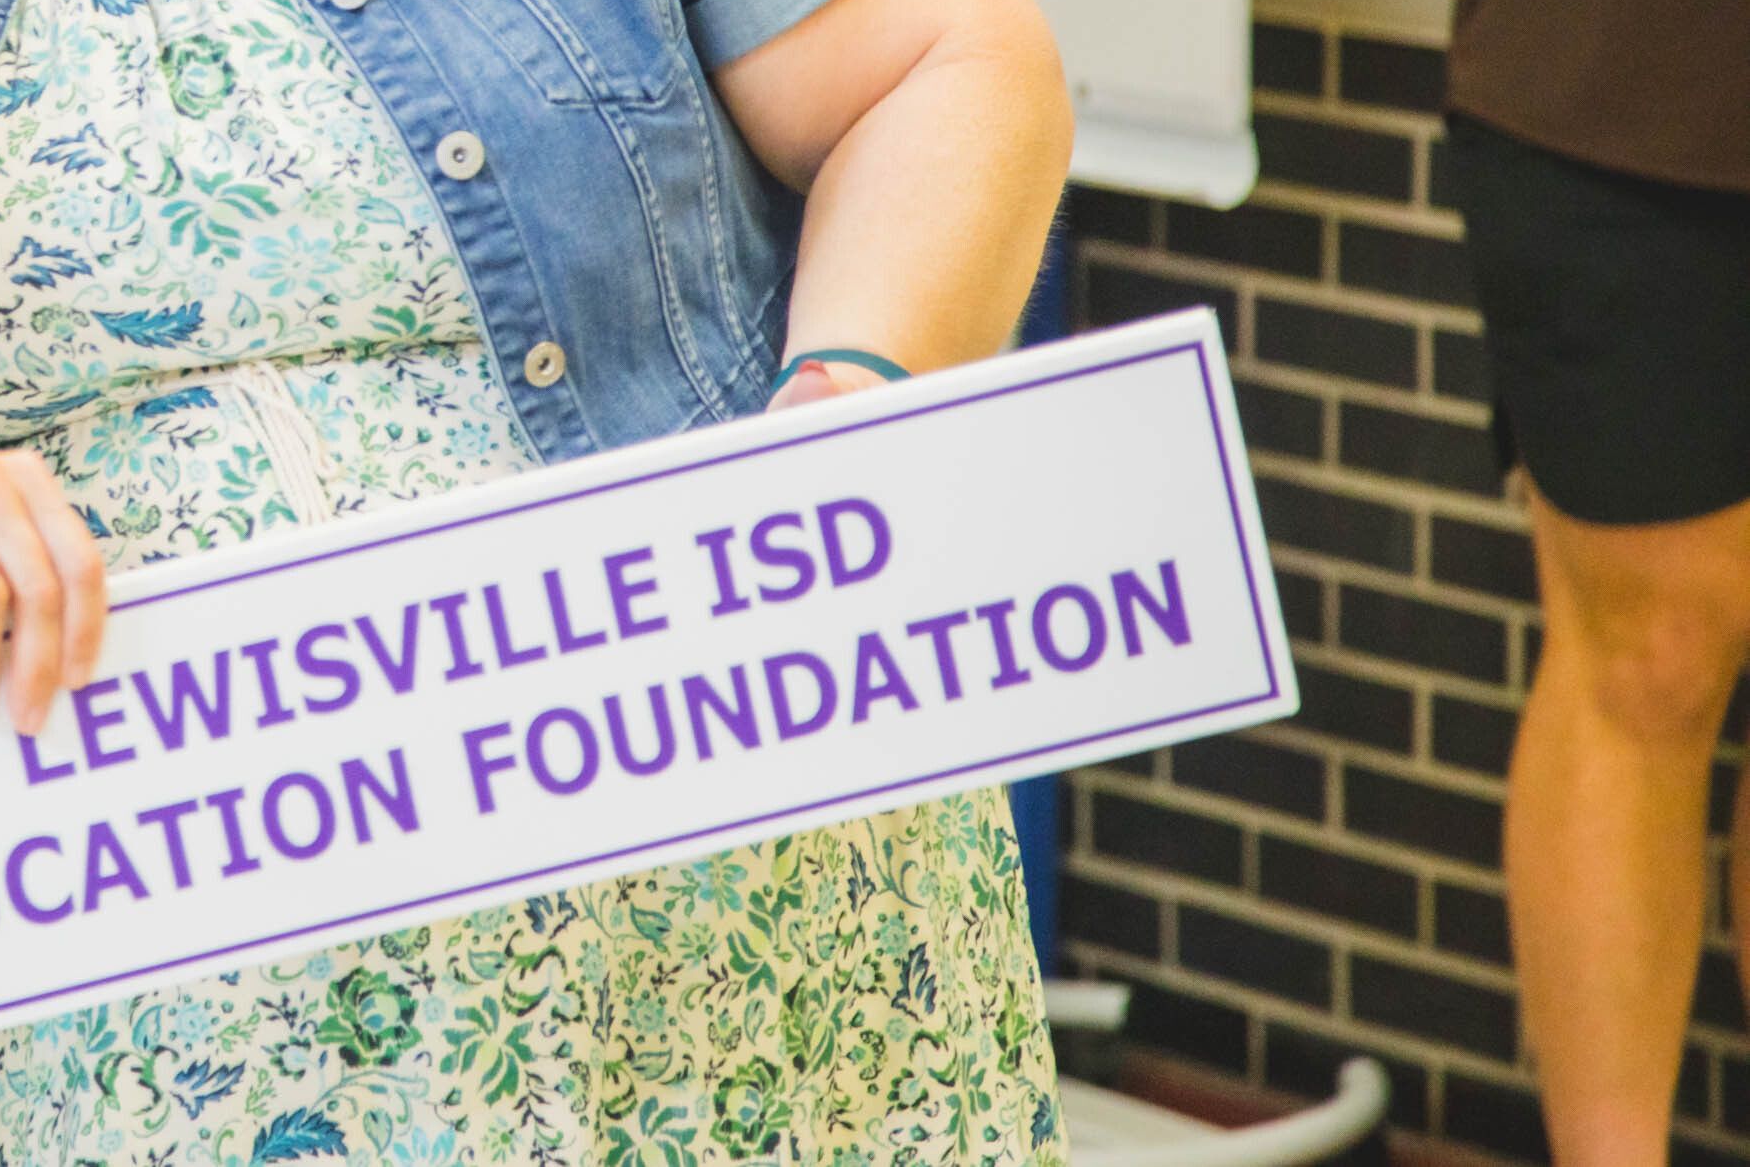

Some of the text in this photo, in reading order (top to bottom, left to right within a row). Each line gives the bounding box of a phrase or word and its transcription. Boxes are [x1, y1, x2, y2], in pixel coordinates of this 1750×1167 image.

[15, 498, 891, 786] LEWISVILLE ISD
[462, 560, 1191, 814] FOUNDATION
